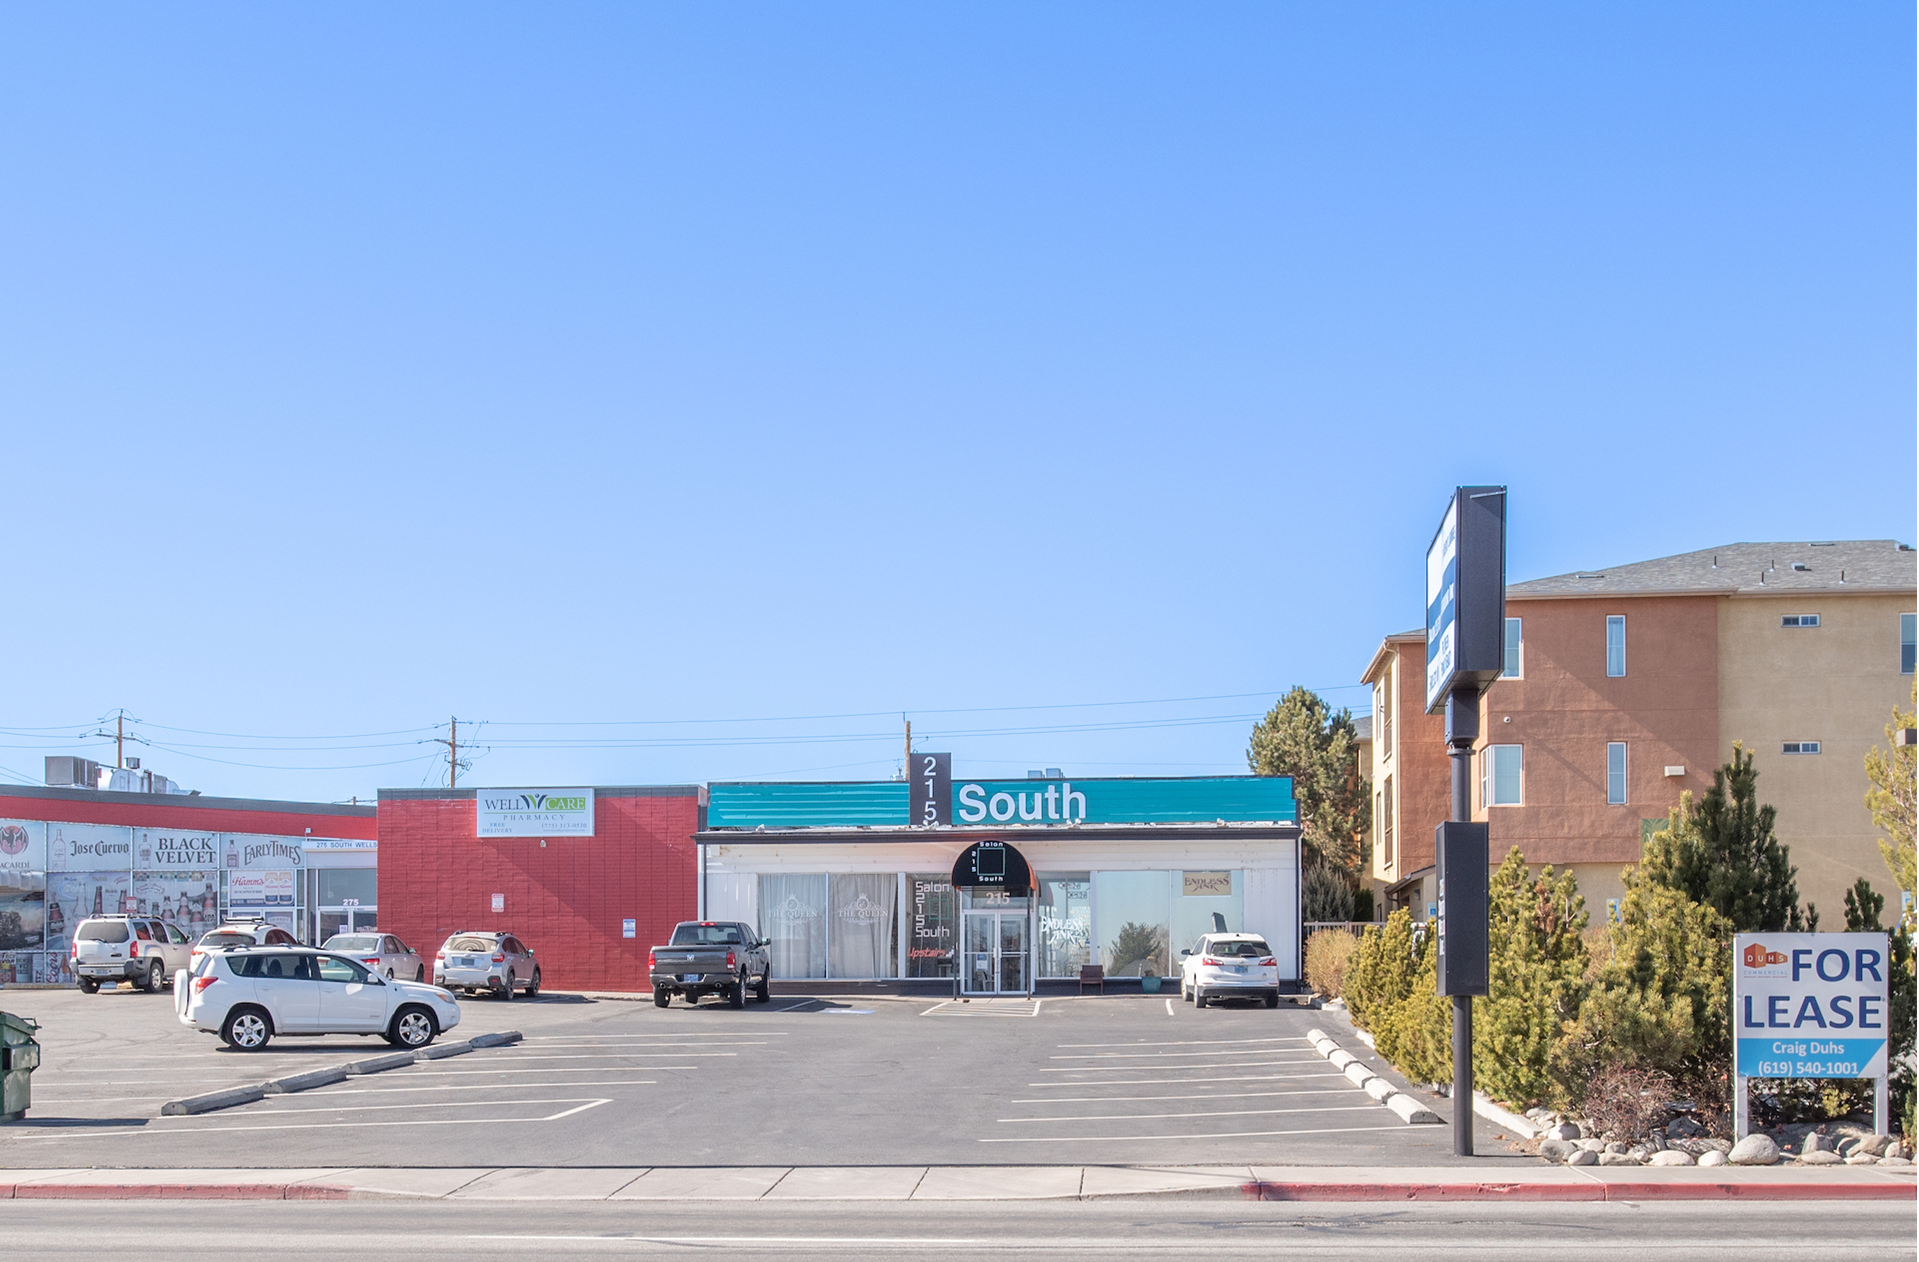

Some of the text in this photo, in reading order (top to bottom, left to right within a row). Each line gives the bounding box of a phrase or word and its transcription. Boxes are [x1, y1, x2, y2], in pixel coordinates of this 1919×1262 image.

[923, 756, 937, 821] 215
[484, 798, 585, 810] WELL CARE
[958, 783, 1086, 822] South
[70, 840, 130, 856] Jose Cuervo
[158, 838, 213, 851] BLACK
[155, 851, 216, 864] VELVET
[0, 860, 30, 869] ACARDÍ
[915, 881, 950, 893] Salon
[342, 898, 359, 906] 275
[986, 892, 1011, 905] 215
[767, 910, 818, 918] THE QUEEN
[838, 910, 888, 918] THE QUEEN
[915, 926, 950, 938] South
[906, 947, 946, 960] Upstairs
[1747, 954, 1785, 963] DUHS
[1791, 948, 1882, 983] FOR
[1744, 995, 1882, 1029] LEASE
[1772, 1041, 1845, 1057] Craig Duhs
[1758, 1060, 1859, 1076] (619) 540-1001
